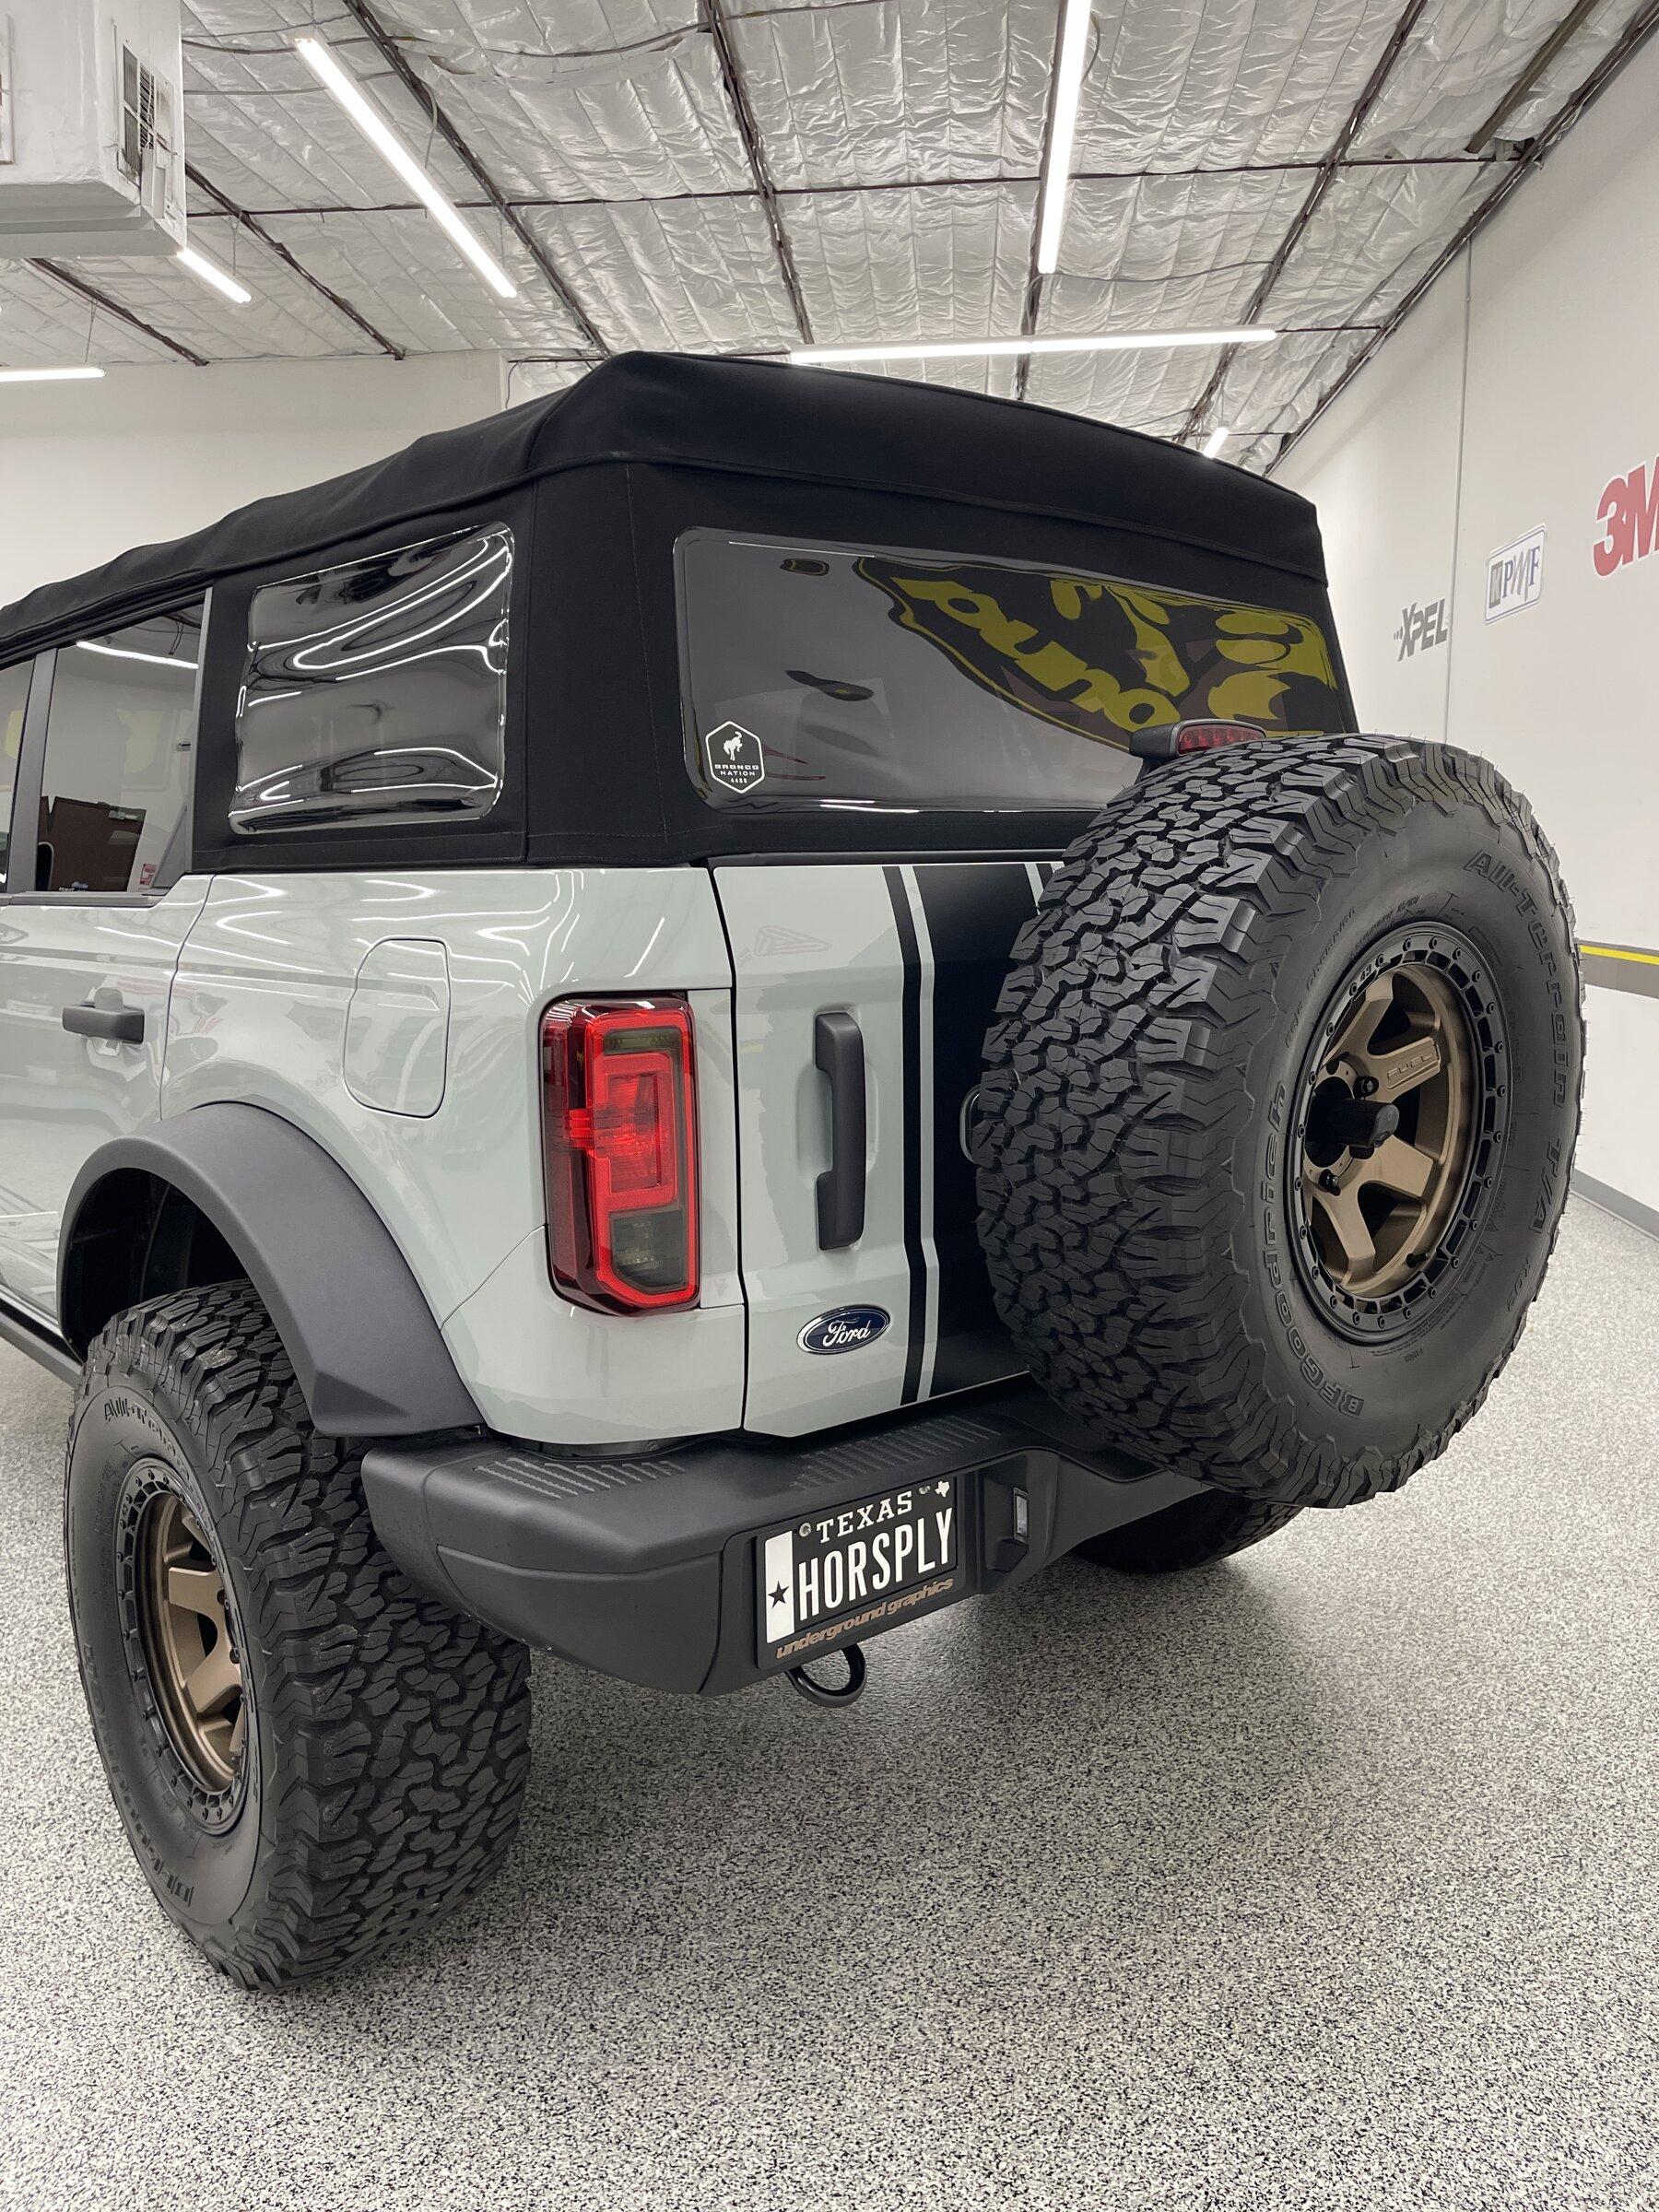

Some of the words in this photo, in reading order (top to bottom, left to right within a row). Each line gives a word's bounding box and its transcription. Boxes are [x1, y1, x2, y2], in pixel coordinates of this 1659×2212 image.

[1397, 597, 1448, 663] XPEL
[1386, 1054, 1433, 1080] FUEL
[1262, 1081, 1365, 1418] BFGoodrich
[822, 1317, 872, 1347] Ford
[816, 1490, 912, 1544] TEXAS
[798, 1507, 953, 1622] HORSPLY
[776, 1602, 888, 1660] underground
[886, 1577, 955, 1616] graphics
